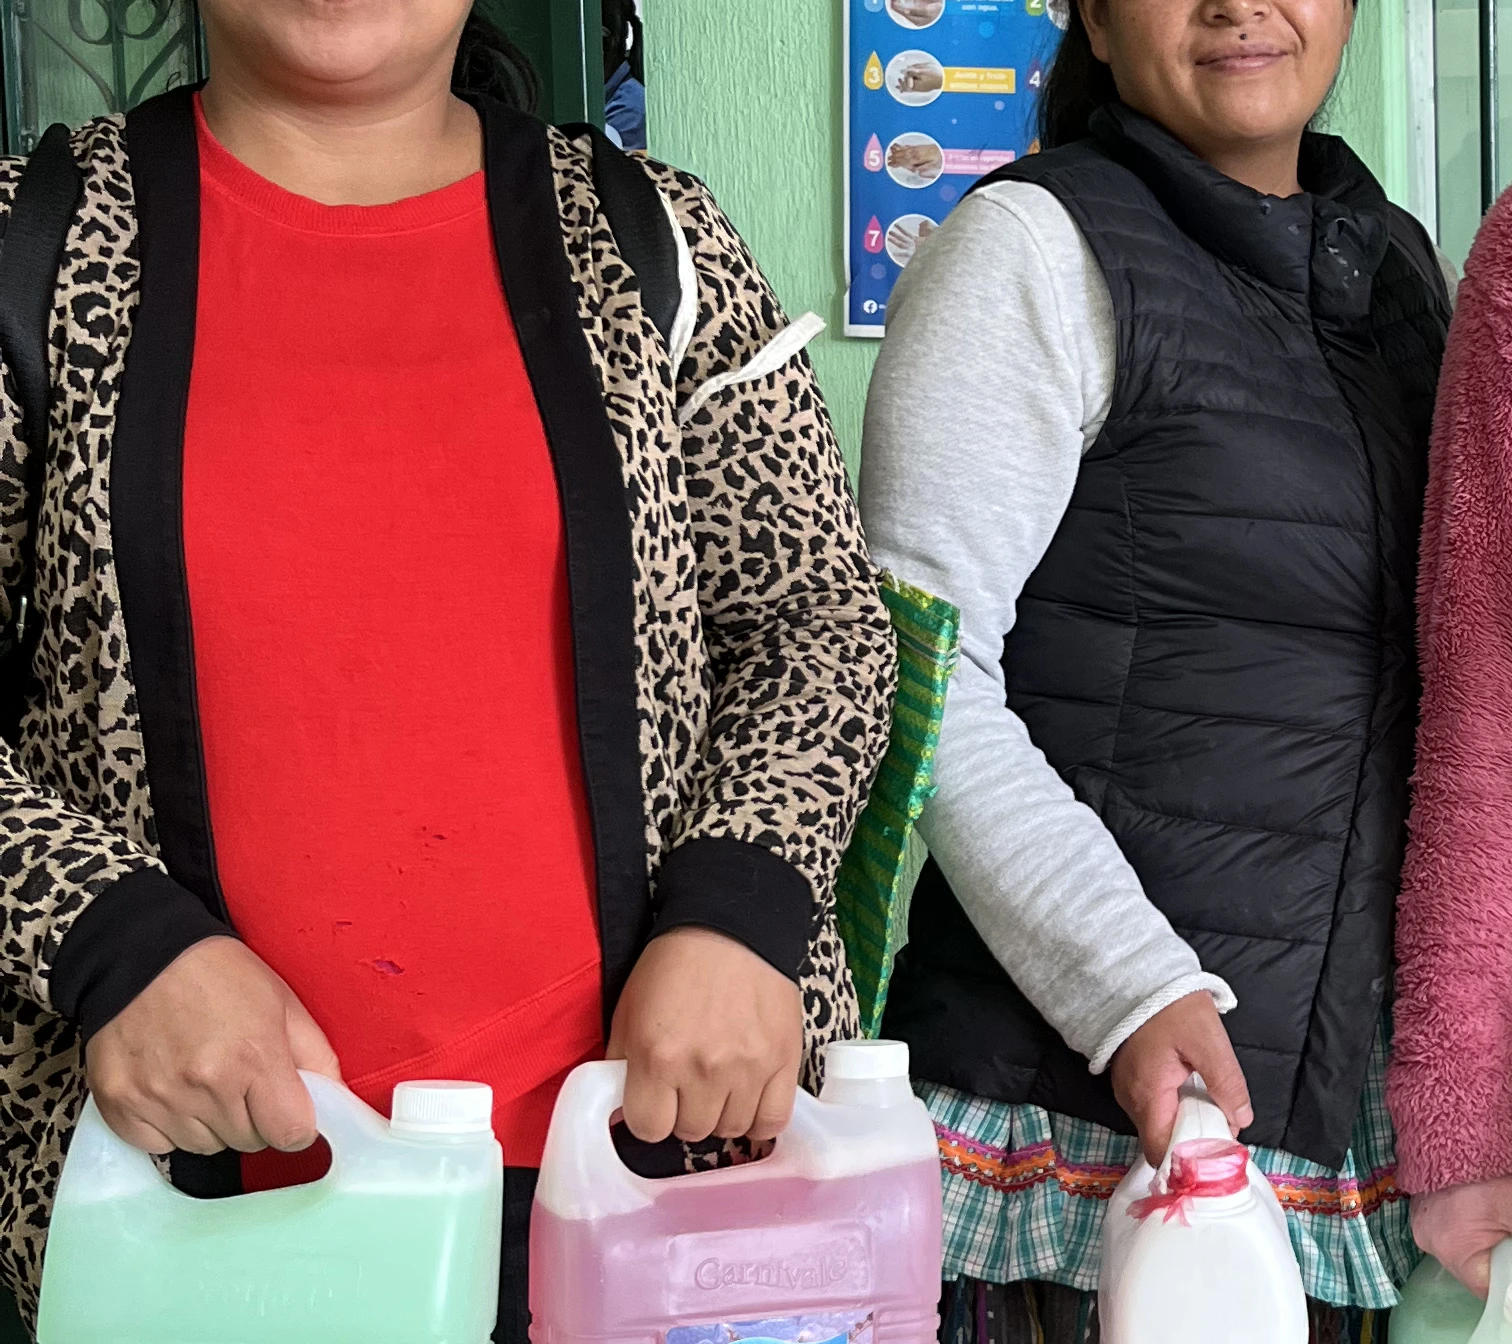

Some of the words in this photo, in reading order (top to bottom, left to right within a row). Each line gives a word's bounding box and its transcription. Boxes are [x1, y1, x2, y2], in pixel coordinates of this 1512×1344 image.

[869, 67, 880, 84] 3
[1029, 70, 1040, 87] 4
[869, 150, 880, 166] 5
[869, 231, 880, 246] 7
[695, 1256, 848, 1290] Carnivale
